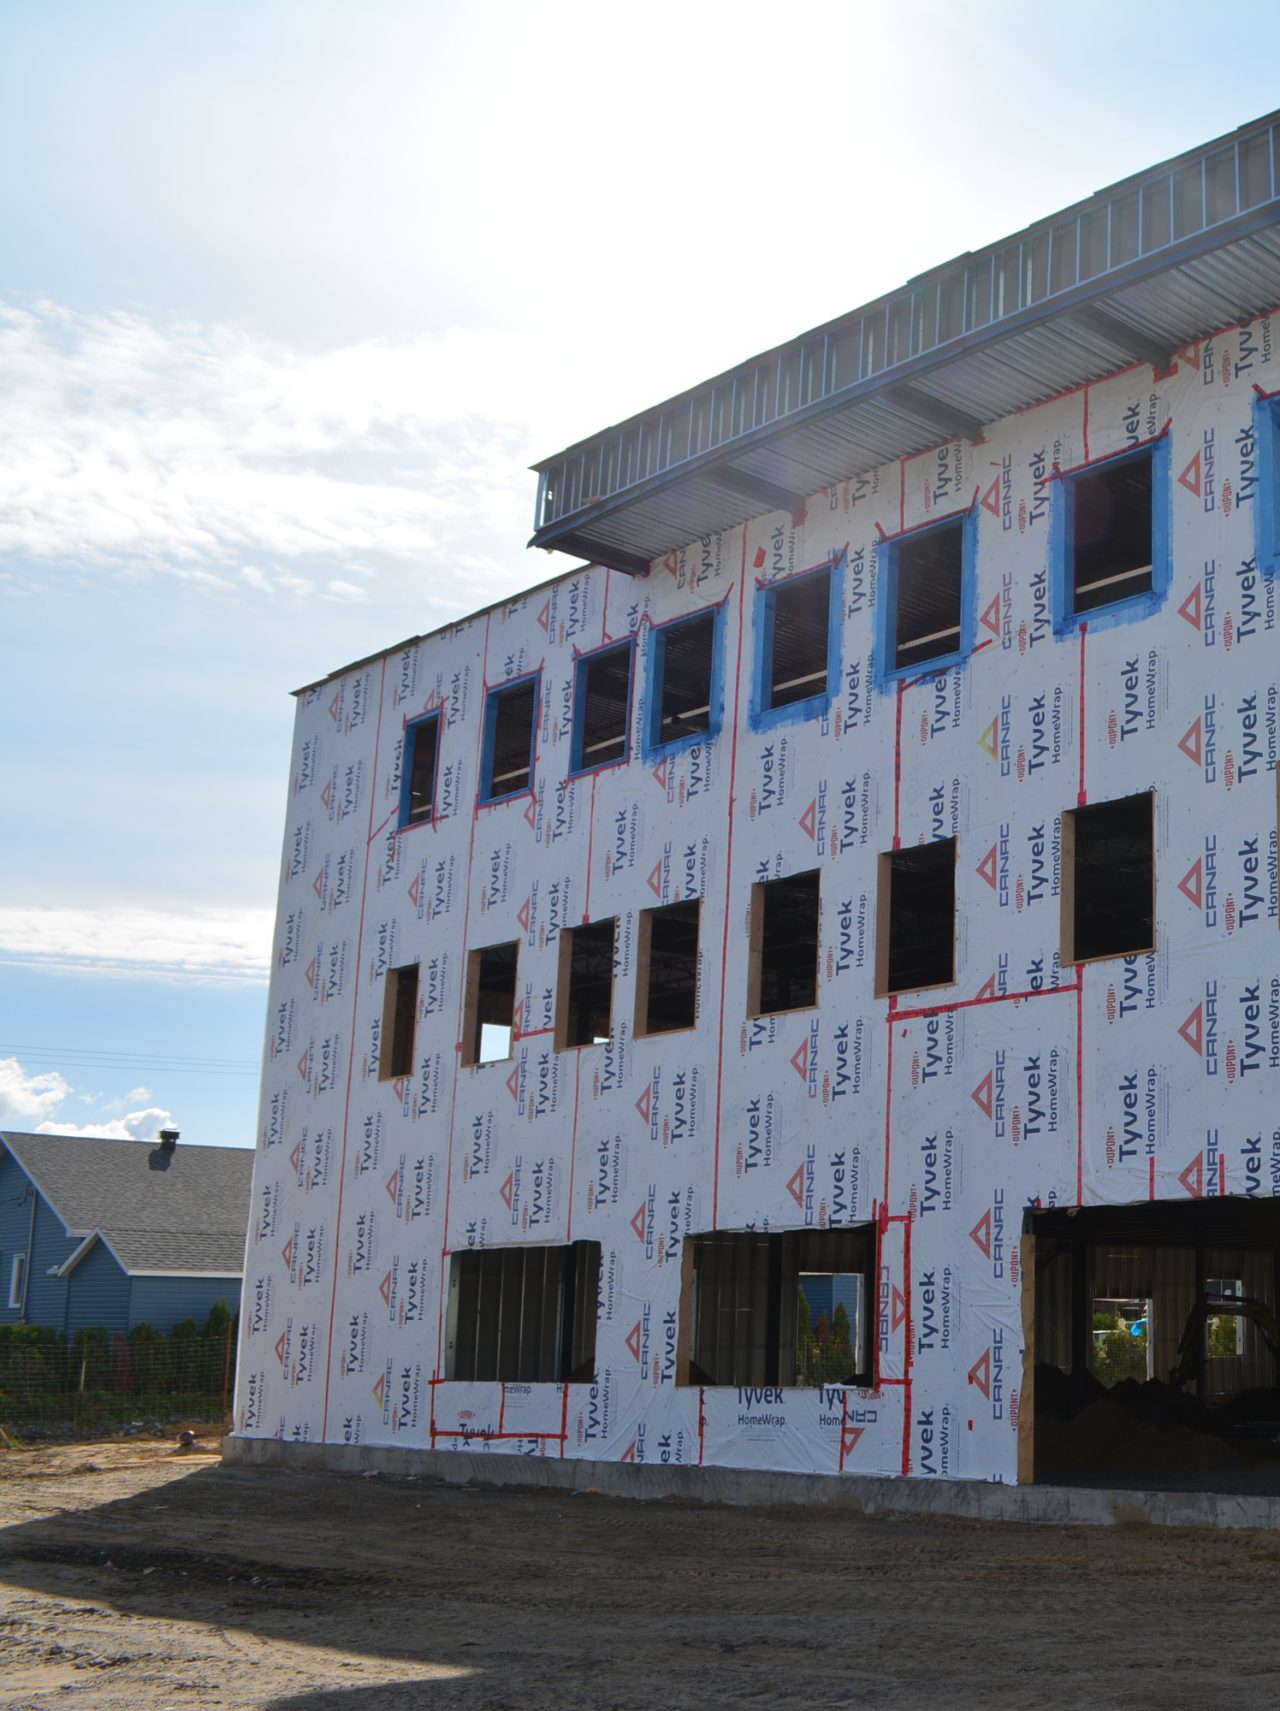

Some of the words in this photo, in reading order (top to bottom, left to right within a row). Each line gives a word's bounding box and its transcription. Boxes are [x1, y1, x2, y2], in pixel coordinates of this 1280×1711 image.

[1029, 449, 1050, 526] Tyvek
[1235, 425, 1259, 508] Tyvek
[848, 547, 866, 619] Tyvek
[1030, 570, 1051, 648] Tyvek
[1236, 557, 1261, 643] Tyvek
[844, 662, 862, 734] Tyvek
[1052, 687, 1063, 764] HomeWrap
[1121, 658, 1143, 742] Tyvek
[1146, 651, 1158, 729] HomeWrap
[1028, 695, 1049, 775] Tyvek
[1237, 695, 1263, 783] Tyvek
[1266, 687, 1278, 771] HomeWrap
[759, 745, 776, 815] Tyvek
[777, 738, 788, 806] HomeWrap
[612, 810, 627, 875] Tyvek
[840, 779, 858, 854] Tyvek
[860, 773, 870, 844] HomeWrap
[334, 854, 346, 909] Tyvek
[1027, 824, 1049, 906] Tyvek
[1051, 818, 1061, 896] HomeWrap
[1238, 837, 1264, 928] Tyvek
[1267, 831, 1278, 918] HomeWrap
[375, 923, 387, 980] Tyvek
[622, 912, 633, 977] HomeWrap
[836, 900, 854, 976] Tyvek
[856, 895, 867, 967] HomeWrap
[617, 1022, 627, 1088] HomeWrap
[852, 1019, 864, 1094] HomeWrap
[1240, 985, 1266, 1077] Tyvek
[1269, 979, 1280, 1067] HomeWrap
[832, 1024, 851, 1102] Tyvek
[1024, 1057, 1046, 1140] Tyvek
[1048, 1050, 1059, 1132] HomeWrap
[671, 1072, 687, 1144] Tyvek
[688, 1068, 699, 1137] HomeWrap
[745, 1099, 762, 1173] Tyvek
[763, 1094, 774, 1166] HomeWrap
[1119, 1074, 1143, 1162] Tyvek
[1145, 1069, 1157, 1154] HomeWrap
[360, 1116, 373, 1175] Tyvek
[595, 1140, 610, 1209] Tyvek
[611, 1136, 621, 1203] HomeWrap
[920, 1136, 940, 1217] Tyvek
[943, 1131, 954, 1210] HomeWrap
[411, 1159, 424, 1220] Tyvek
[544, 1158, 555, 1223] HomeWrap
[353, 1215, 365, 1274] Tyvek
[665, 1191, 680, 1263] Tyvek
[252, 1279, 264, 1335] Tyvek
[405, 1262, 418, 1324] Tyvek
[606, 1251, 616, 1320] HomeWrap
[918, 1272, 939, 1354] Tyvek
[941, 1268, 952, 1348] HomeWrap
[346, 1316, 359, 1376] Tyvek
[245, 1375, 257, 1430] Tyvek
[585, 1373, 601, 1442] Tyvek
[601, 1369, 611, 1439] HomeWrap
[736, 1388, 783, 1410] Tyvek
[738, 1414, 785, 1427] HomeWrap
